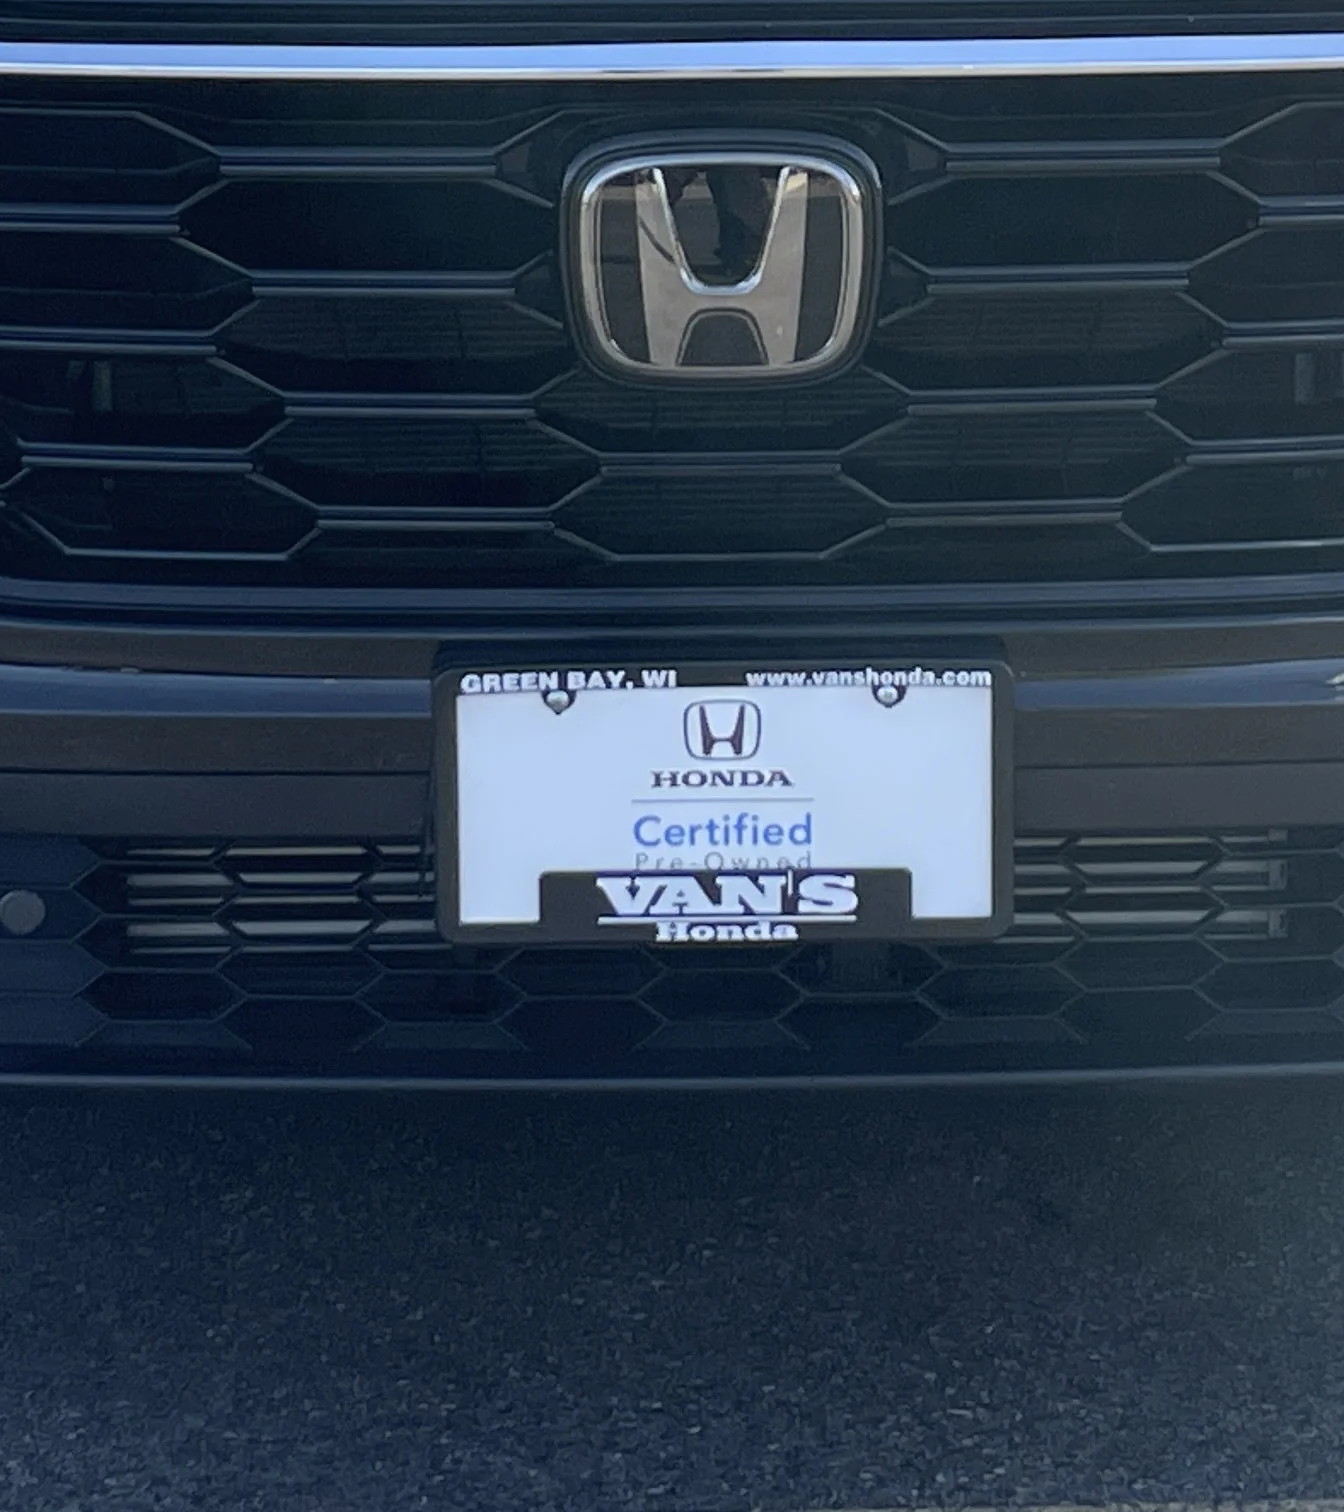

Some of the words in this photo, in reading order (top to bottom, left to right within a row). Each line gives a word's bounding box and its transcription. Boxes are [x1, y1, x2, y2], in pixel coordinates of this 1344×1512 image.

[459, 671, 560, 694] GREEN
[566, 670, 635, 691] BAY,
[641, 669, 678, 689] WI
[745, 666, 992, 688] www.vanshonda.com
[650, 769, 795, 789] HONDA
[633, 811, 812, 847] Certified
[634, 850, 812, 870] Pre-Owned
[595, 868, 859, 916] VAN'S
[655, 920, 799, 942] Honda
